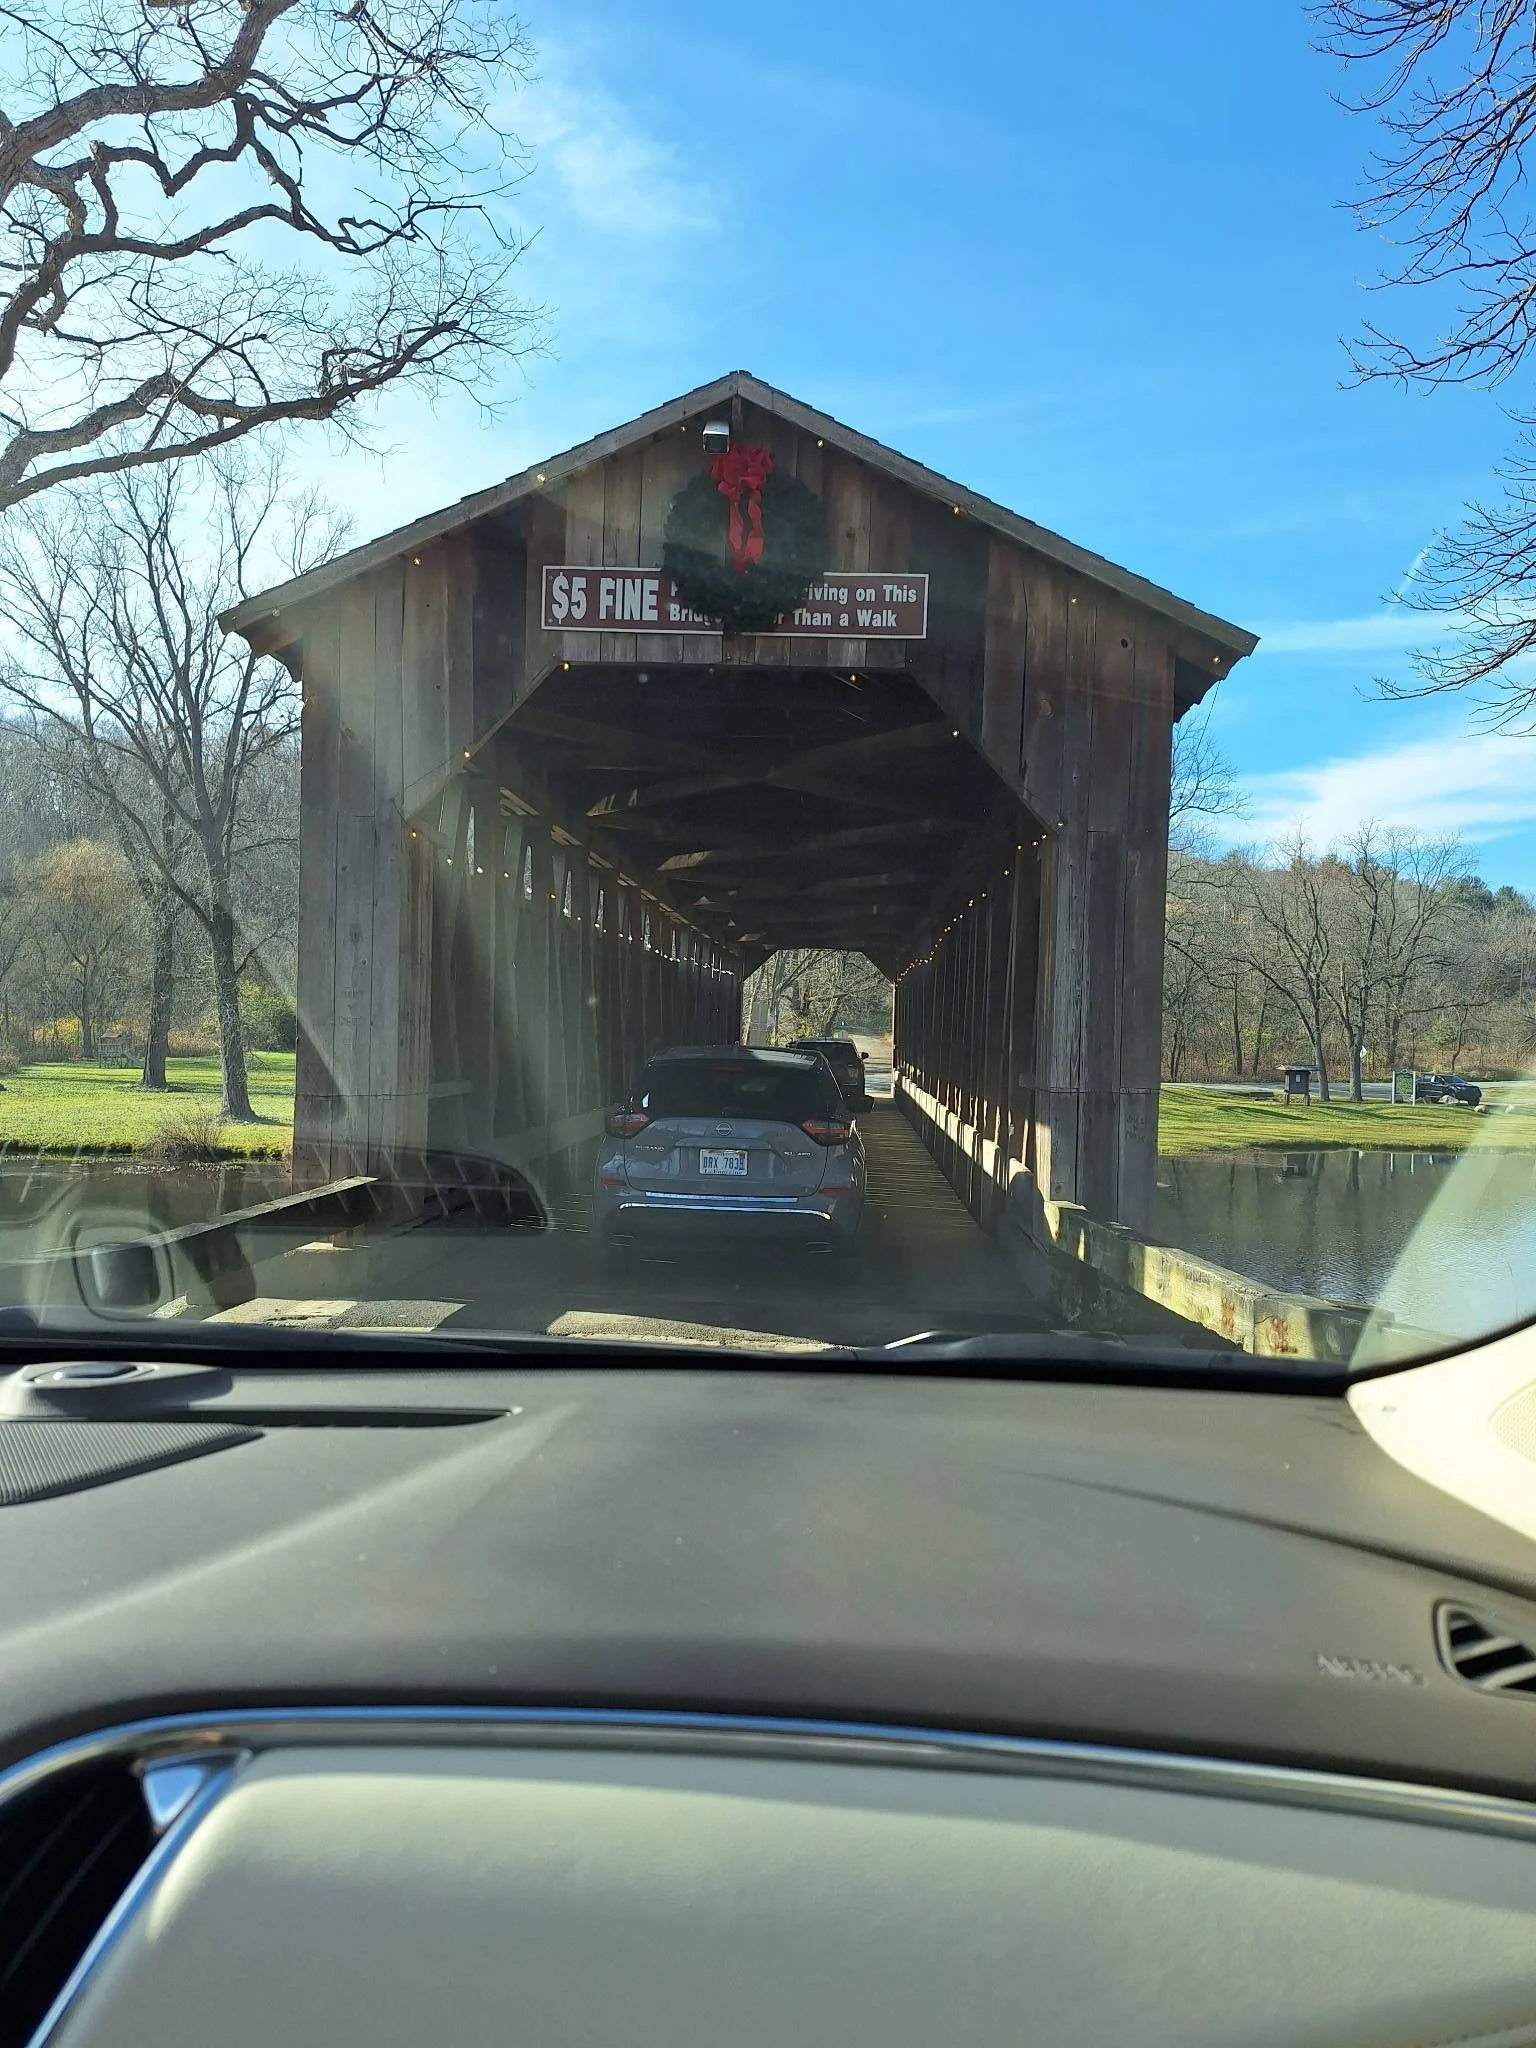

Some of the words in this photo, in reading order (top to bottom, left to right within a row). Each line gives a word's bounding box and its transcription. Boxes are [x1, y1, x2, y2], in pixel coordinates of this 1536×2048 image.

[552, 571, 587, 624] $5
[600, 577, 659, 621] FINE
[804, 583, 848, 604] iving
[855, 587, 876, 602] on
[883, 584, 917, 603] This
[669, 603, 722, 626] Brid
[792, 607, 832, 626] Than
[839, 613, 849, 626] a
[857, 608, 897, 627] Walk
